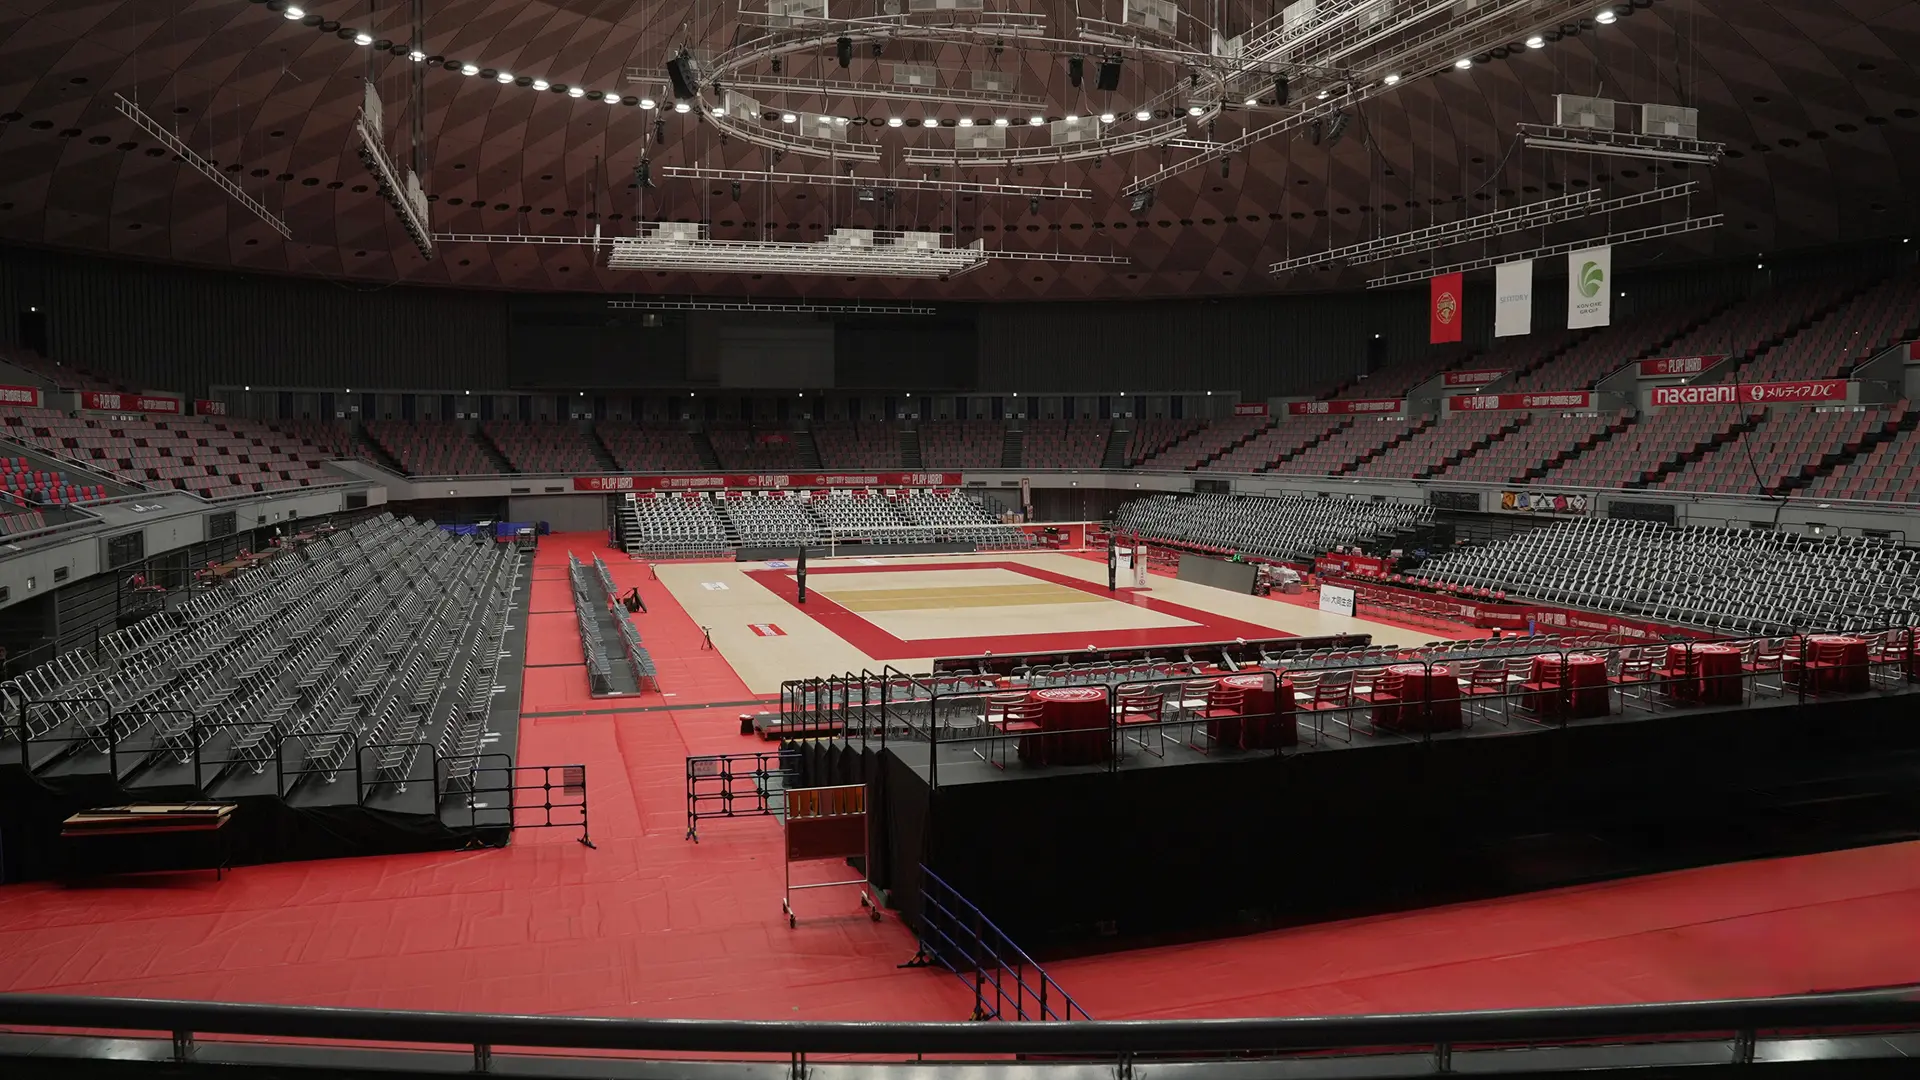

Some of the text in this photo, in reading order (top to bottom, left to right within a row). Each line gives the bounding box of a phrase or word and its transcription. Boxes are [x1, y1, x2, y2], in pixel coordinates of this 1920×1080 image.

[1668, 359, 1685, 373] PLAY
[601, 477, 634, 489] PLAY HARD
[758, 475, 774, 486] PLAY
[912, 474, 943, 485] PLAY HARD
[1537, 612, 1555, 624] PLAY
